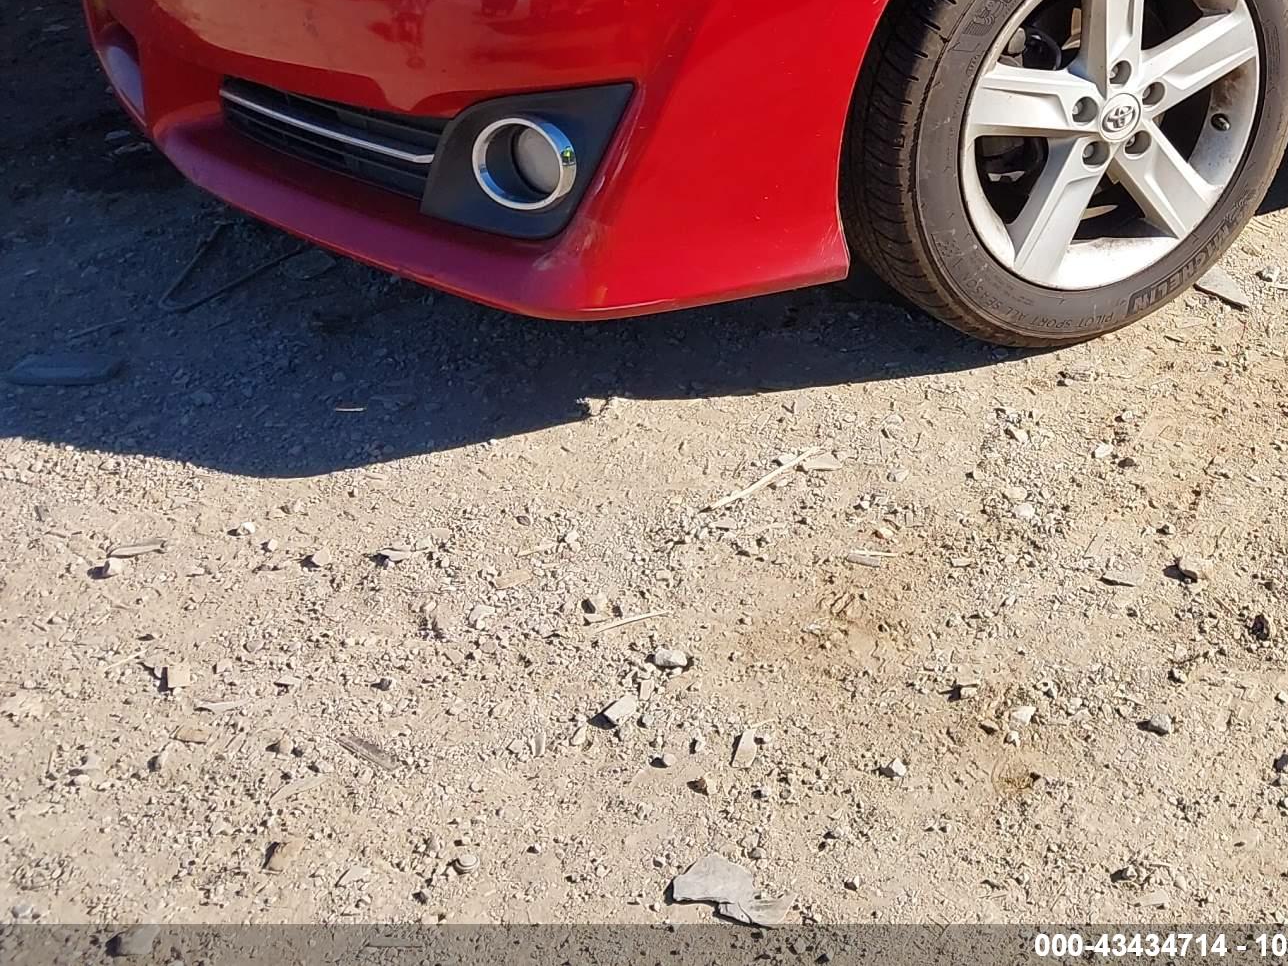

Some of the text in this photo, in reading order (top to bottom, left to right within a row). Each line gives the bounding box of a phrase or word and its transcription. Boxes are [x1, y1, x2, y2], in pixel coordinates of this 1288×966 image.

[1134, 226, 1231, 312] MICHELIN
[1008, 307, 1026, 321] ALL
[1078, 312, 1114, 327] PILOT
[1031, 316, 1072, 328] SPORT
